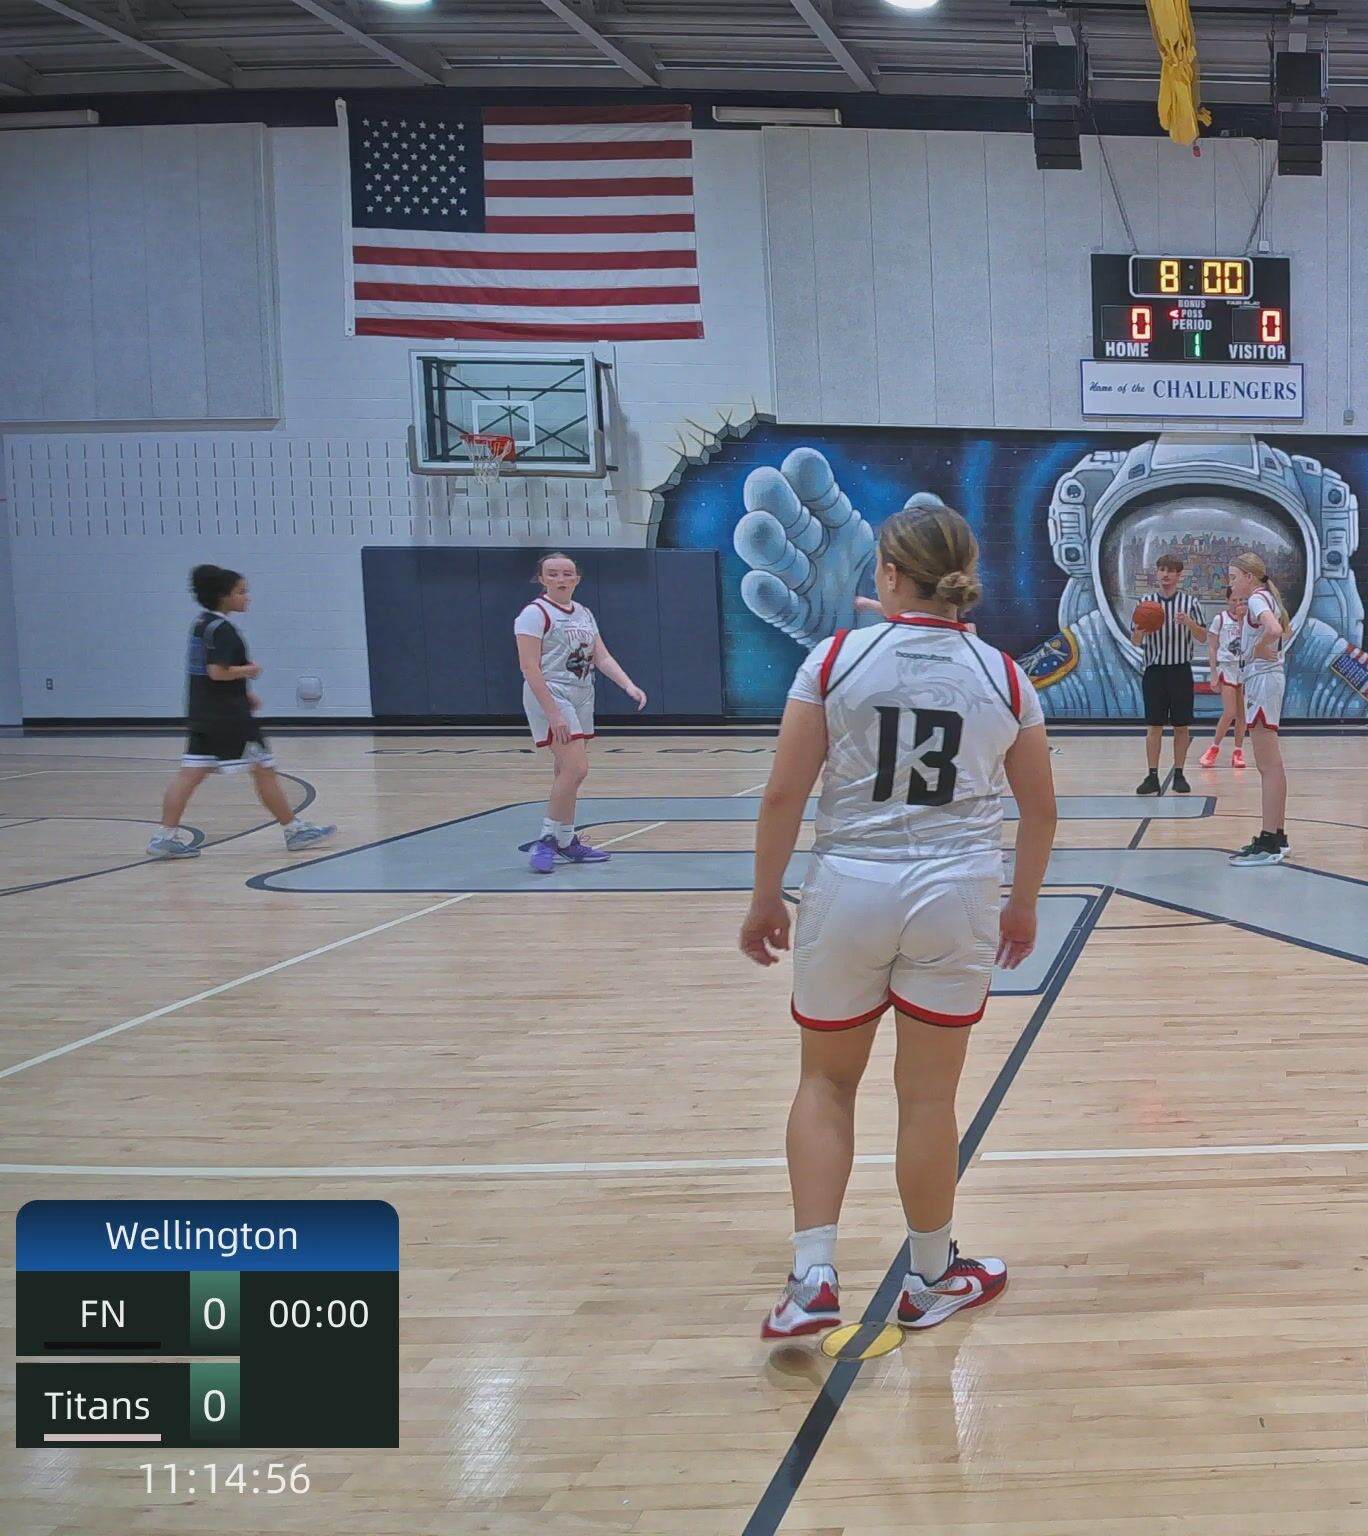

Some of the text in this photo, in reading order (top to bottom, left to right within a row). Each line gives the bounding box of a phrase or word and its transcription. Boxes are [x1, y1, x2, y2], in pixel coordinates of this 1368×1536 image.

[1160, 260, 1242, 294] 8:00
[1178, 299, 1207, 308] BONUS
[1181, 309, 1203, 318] POSS
[1131, 308, 1151, 340] 0
[1172, 319, 1212, 331] PERIOD
[1262, 310, 1281, 342] 0
[1105, 342, 1149, 357] HOME
[1194, 332, 1201, 357] 1
[1229, 344, 1286, 360] VISITOR
[1089, 379, 1297, 400] Home of the CHALLENGERS
[872, 706, 964, 807] 13
